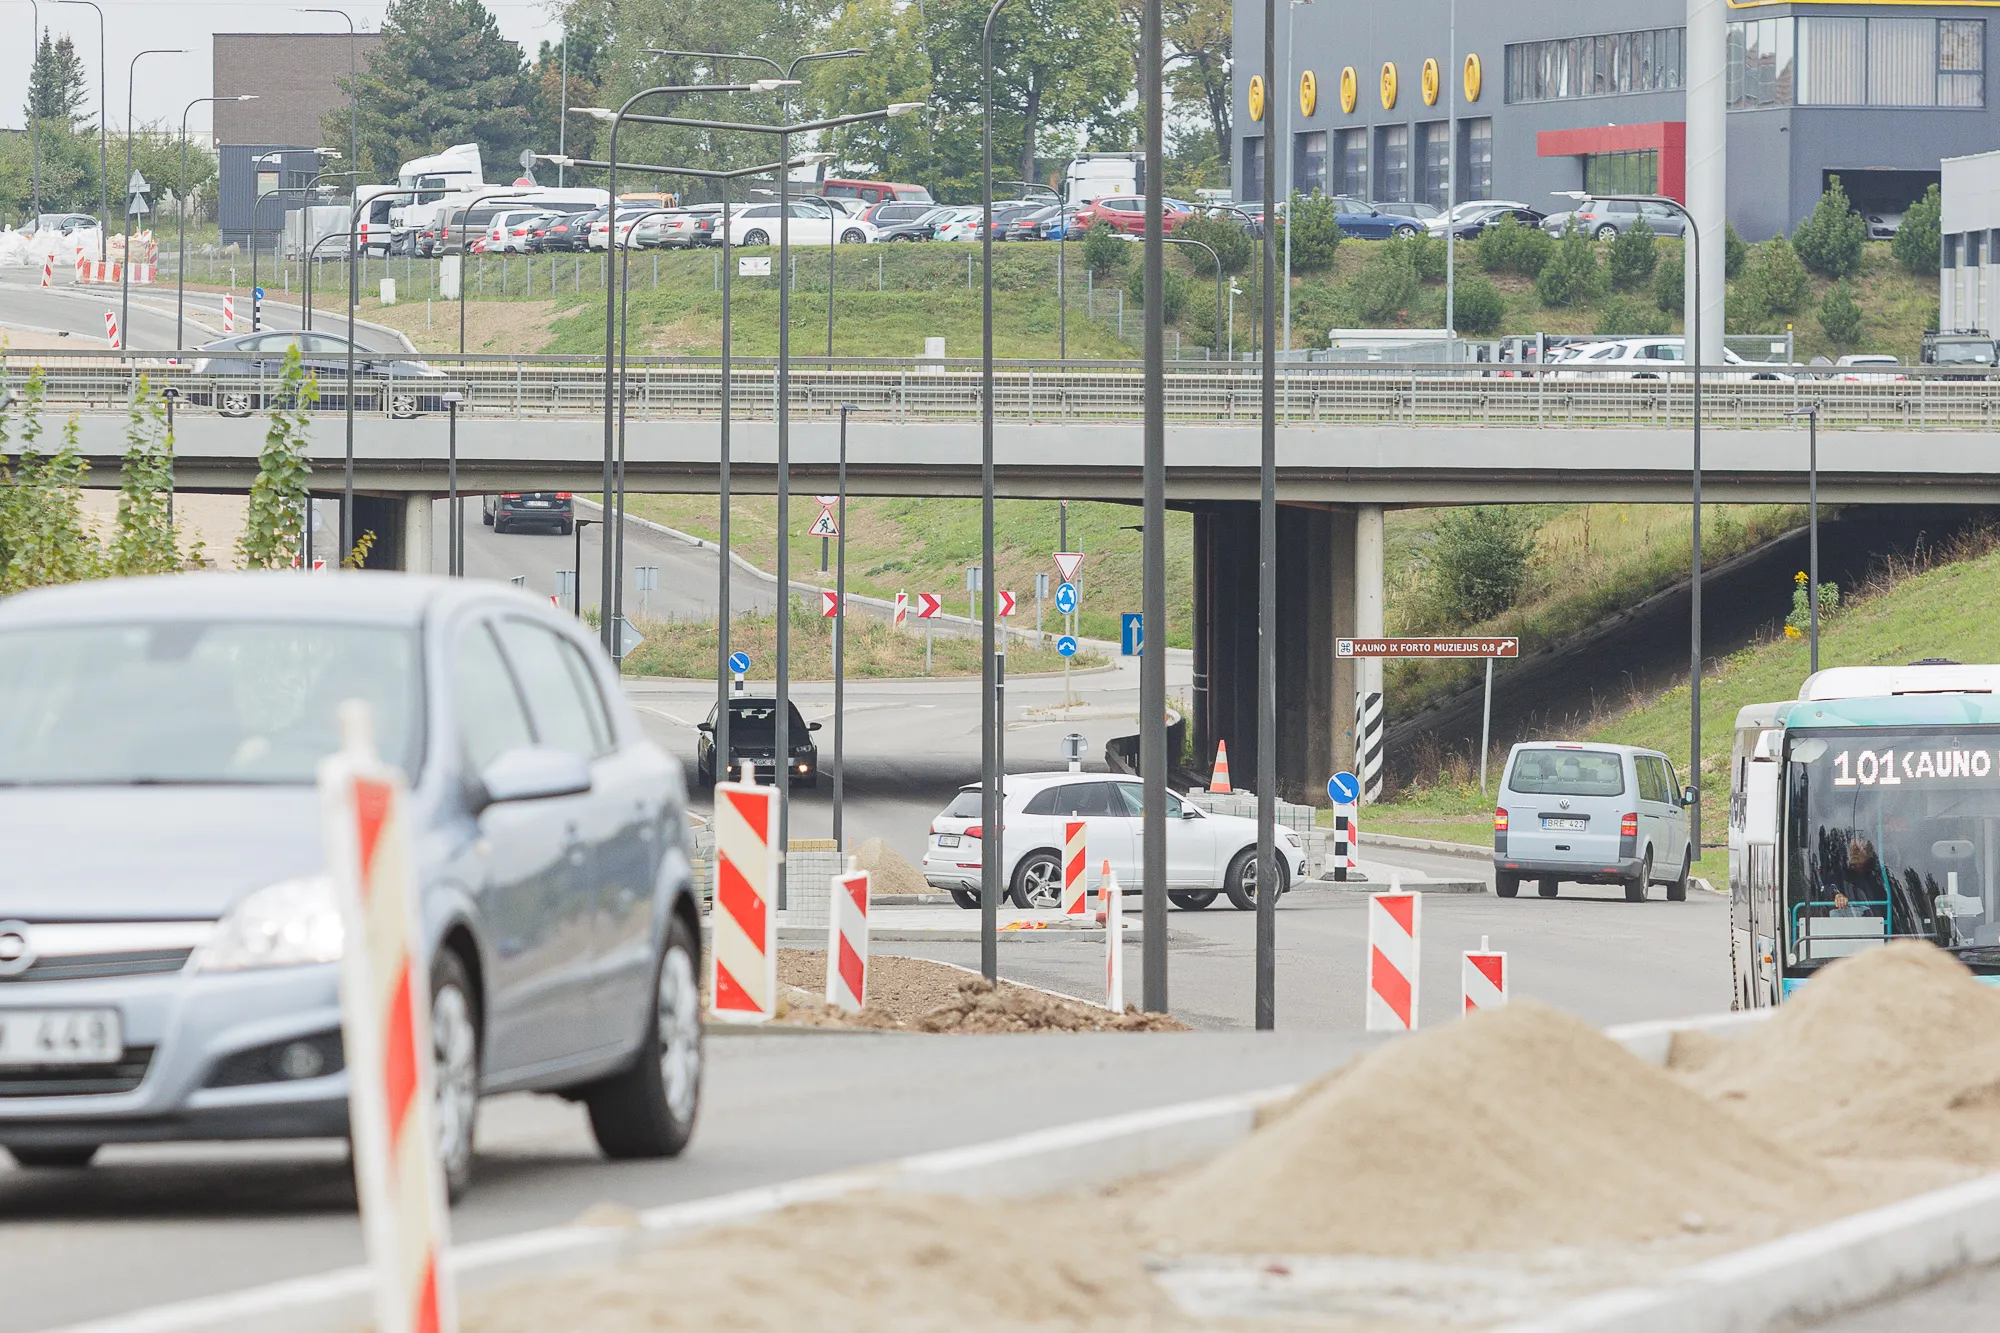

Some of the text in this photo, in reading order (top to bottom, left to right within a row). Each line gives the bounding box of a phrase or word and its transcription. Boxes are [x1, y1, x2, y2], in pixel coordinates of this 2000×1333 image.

[1354, 643, 1495, 653] KAUNO IX FORTO MUZIEJUS 0,8
[1834, 750, 1901, 785] 101
[1548, 819, 1584, 828] BRE 422
